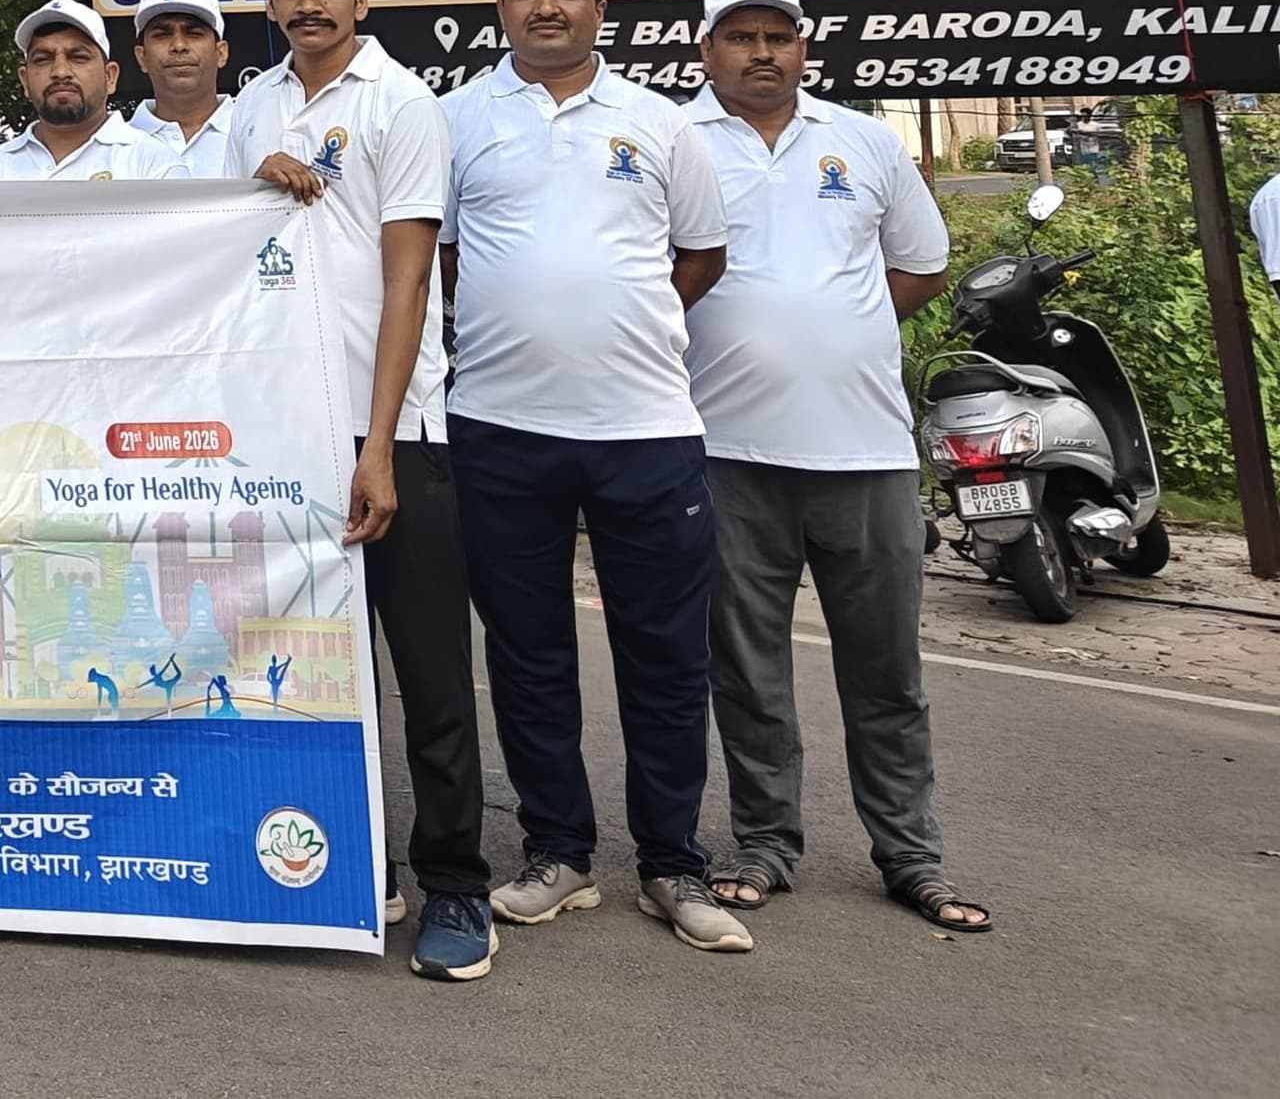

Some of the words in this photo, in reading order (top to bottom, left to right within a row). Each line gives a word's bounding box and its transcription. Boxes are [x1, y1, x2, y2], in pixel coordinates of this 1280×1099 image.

[860, 9, 1103, 43] BARODA,
[1123, 4, 1280, 36] KALI
[854, 55, 1191, 88] 9534188949
[258, 278, 279, 287] Yoga
[119, 431, 143, 452] 21st
[146, 431, 181, 451] June
[184, 430, 219, 450] 2026
[46, 477, 99, 508] Yoga
[104, 477, 135, 501] for
[140, 476, 222, 506] Healthy
[230, 476, 304, 506] Ageing
[8, 772, 39, 796] के
[46, 771, 144, 797] सौजन्य
[150, 772, 179, 798] से
[97, 855, 211, 886] झारखण्ड
